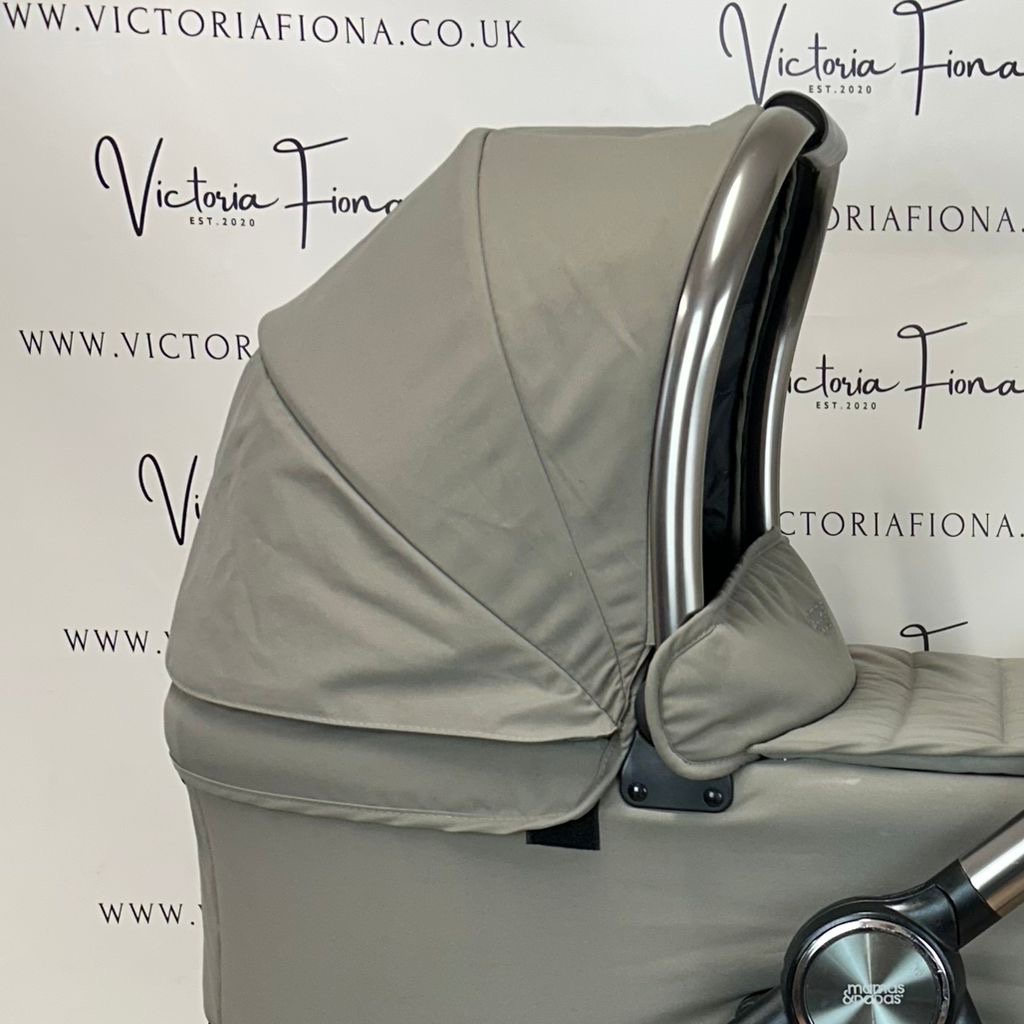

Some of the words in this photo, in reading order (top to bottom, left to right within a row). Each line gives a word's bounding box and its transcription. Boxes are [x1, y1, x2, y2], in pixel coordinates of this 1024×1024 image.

[2, 2, 526, 49] WW.VICTORIAFIONA.CO.UK
[719, 2, 896, 104] Victoria
[808, 84, 872, 95] EST.2020
[94, 134, 280, 238] Victoria
[189, 216, 256, 228] EST.2020
[787, 353, 901, 398] ictoria
[815, 400, 877, 411] EST.2020
